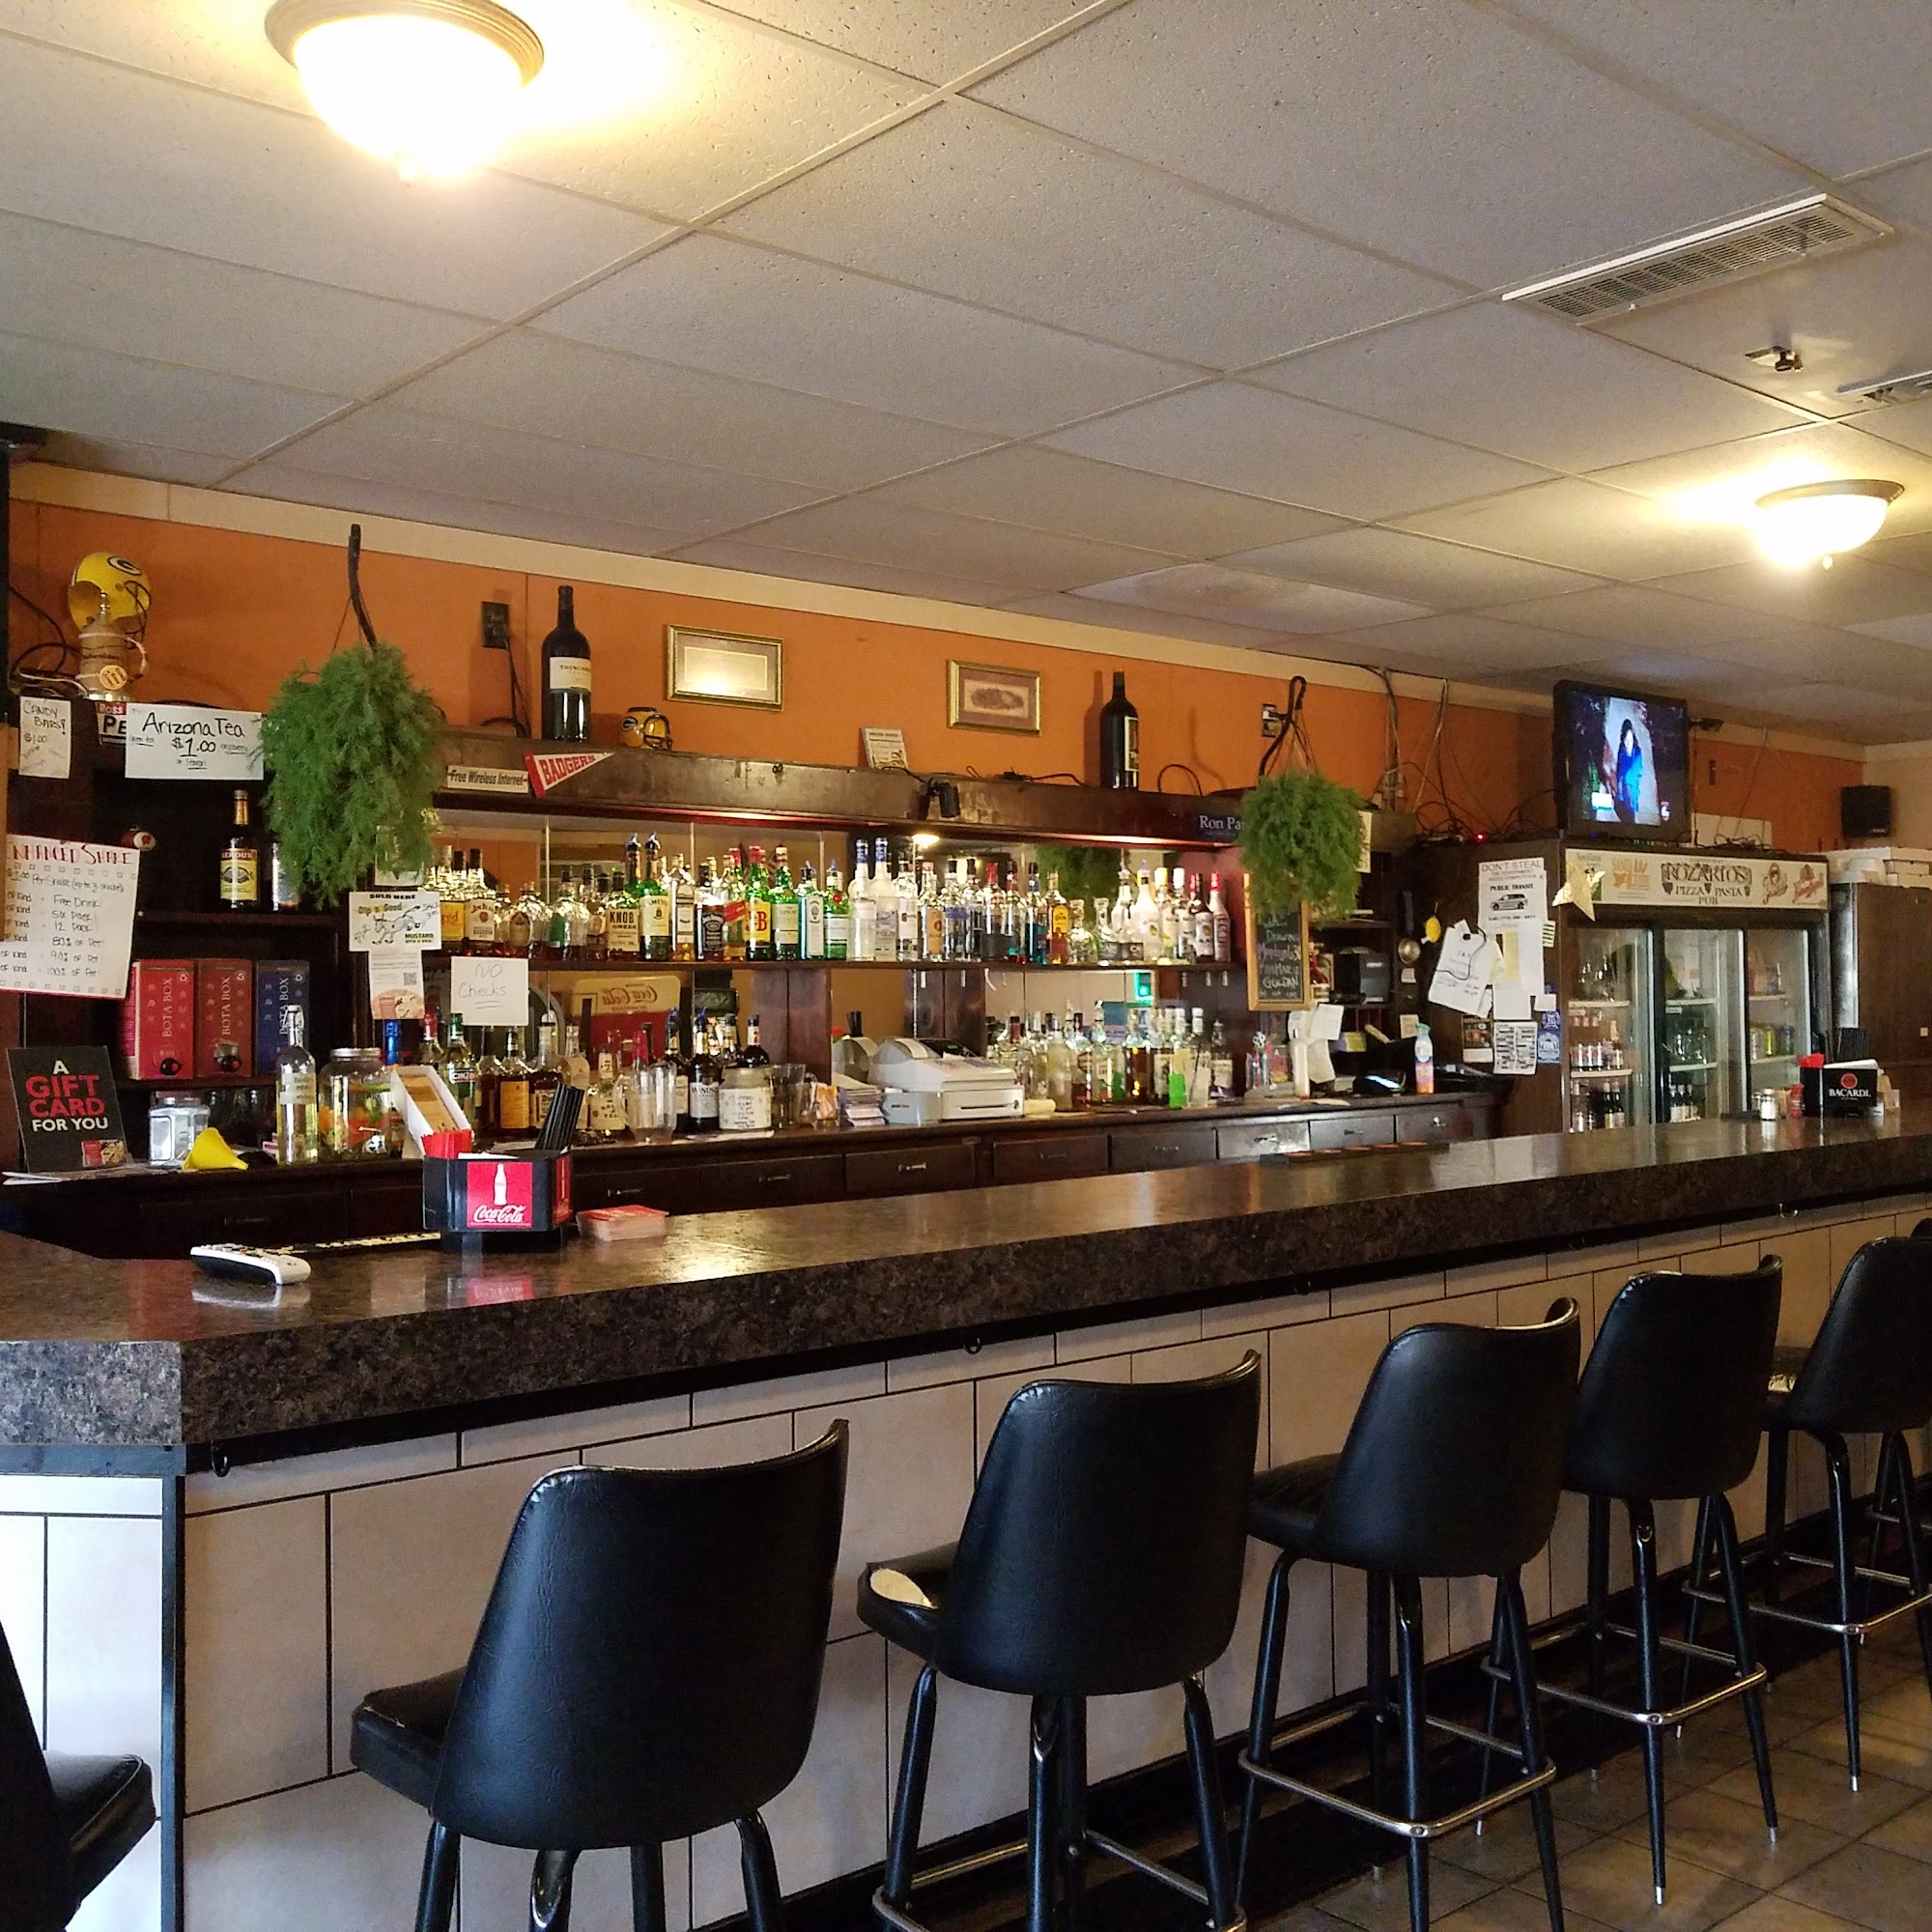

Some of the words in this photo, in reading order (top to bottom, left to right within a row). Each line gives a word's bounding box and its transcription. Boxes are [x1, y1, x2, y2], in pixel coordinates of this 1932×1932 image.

[142, 712, 215, 737] Arizona
[214, 718, 244, 737] Tea
[172, 737, 216, 757] $1.00
[449, 770, 467, 783] Free
[468, 771, 497, 785] Wireless
[1199, 815, 1224, 829] Ron
[1512, 859, 1543, 869] STEAL
[1676, 886, 1705, 895] PIZZA
[1715, 887, 1743, 897] PASTA
[1698, 896, 1719, 905] PUB
[609, 911, 635, 924] KNOB
[54, 921, 66, 931] 12
[475, 963, 503, 979] NO
[162, 977, 173, 1002] BOX
[221, 977, 231, 1001] BOX
[278, 977, 290, 1001] BOX
[458, 982, 508, 999] Checks
[161, 1006, 173, 1037] BOTA
[221, 1004, 232, 1036] BOTA
[53, 1060, 70, 1075] A
[25, 1074, 99, 1098] GIFT
[1828, 1088, 1870, 1097] BACARDI
[29, 1097, 105, 1118] CARD
[32, 1118, 69, 1132] FOR
[70, 1116, 109, 1130] YOU
